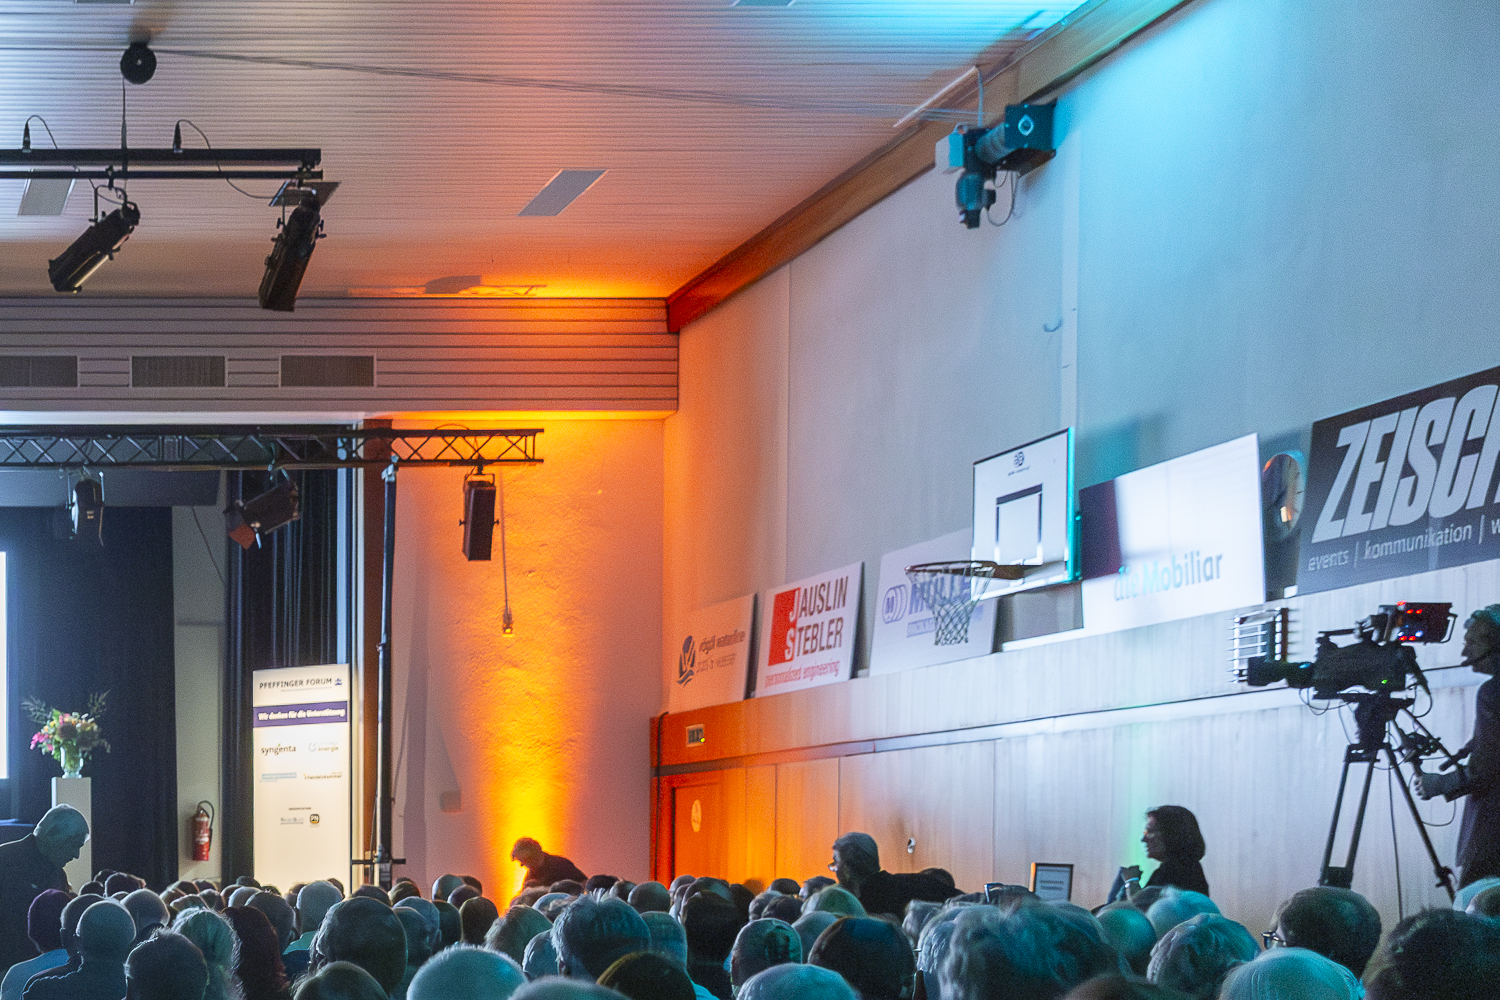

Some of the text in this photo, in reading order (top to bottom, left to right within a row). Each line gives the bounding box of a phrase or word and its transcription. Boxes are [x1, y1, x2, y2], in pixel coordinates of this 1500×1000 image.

[1308, 550, 1349, 571] events
[1364, 523, 1472, 560] kommunikation
[789, 575, 849, 623] JAUSLIN
[785, 616, 844, 660] STEBLER
[259, 679, 304, 690] PFEFFINGER
[306, 677, 332, 686] FORUM
[260, 744, 296, 757] syngenta
